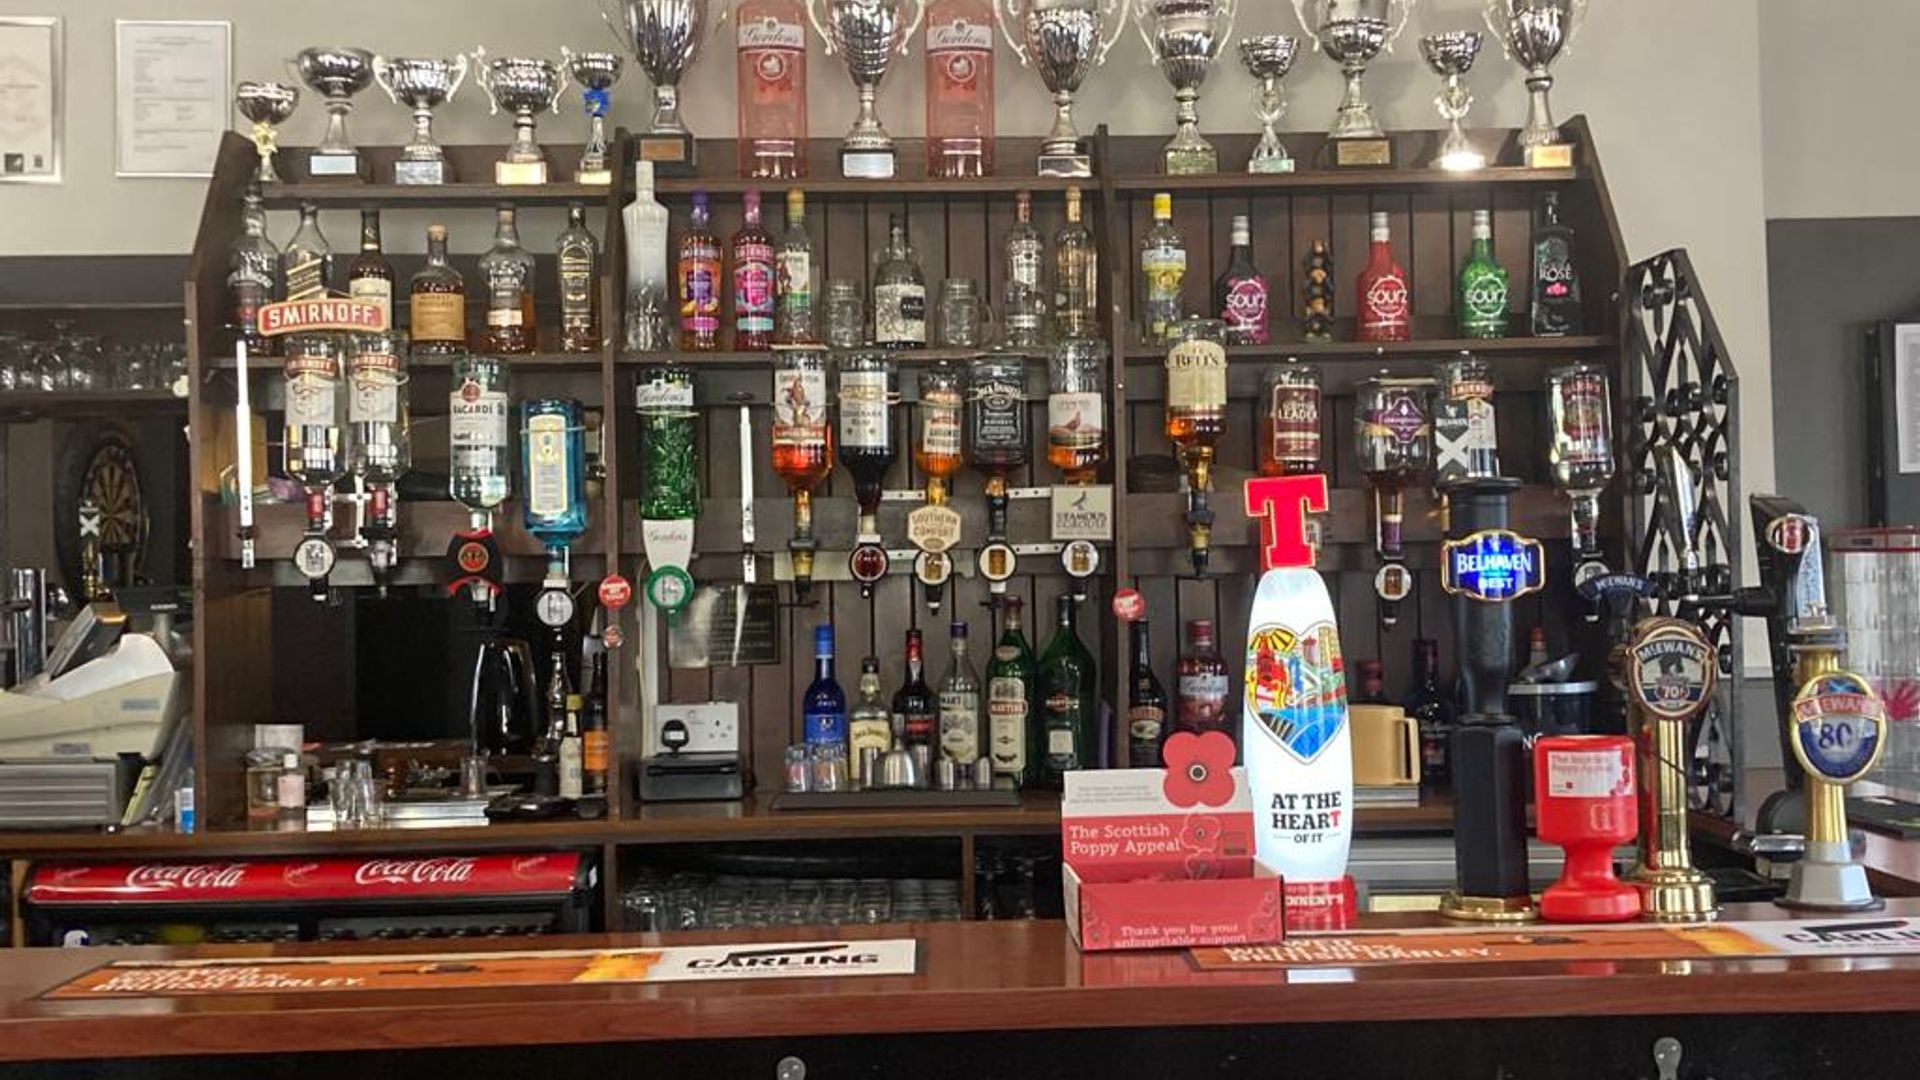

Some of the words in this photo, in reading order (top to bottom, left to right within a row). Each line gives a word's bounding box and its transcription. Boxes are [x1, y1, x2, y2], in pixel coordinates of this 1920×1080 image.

[268, 304, 375, 328] SMIRNOFF
[1243, 475, 1329, 568] T
[1457, 553, 1532, 574] BELHAVEN
[1479, 577, 1514, 589] BEST
[1271, 793, 1298, 810] AT
[1302, 791, 1342, 809] THE
[1271, 810, 1342, 830] HEART
[1069, 825, 1099, 839] The
[1103, 823, 1170, 838] Scottish
[1293, 834, 1309, 844] OF
[1310, 833, 1324, 843] IT
[1070, 840, 1119, 857] Poppy
[1124, 838, 1181, 855] Appeal
[1121, 926, 1159, 937] Thank
[1162, 927, 1186, 937] you
[687, 946, 879, 968] CARLING
